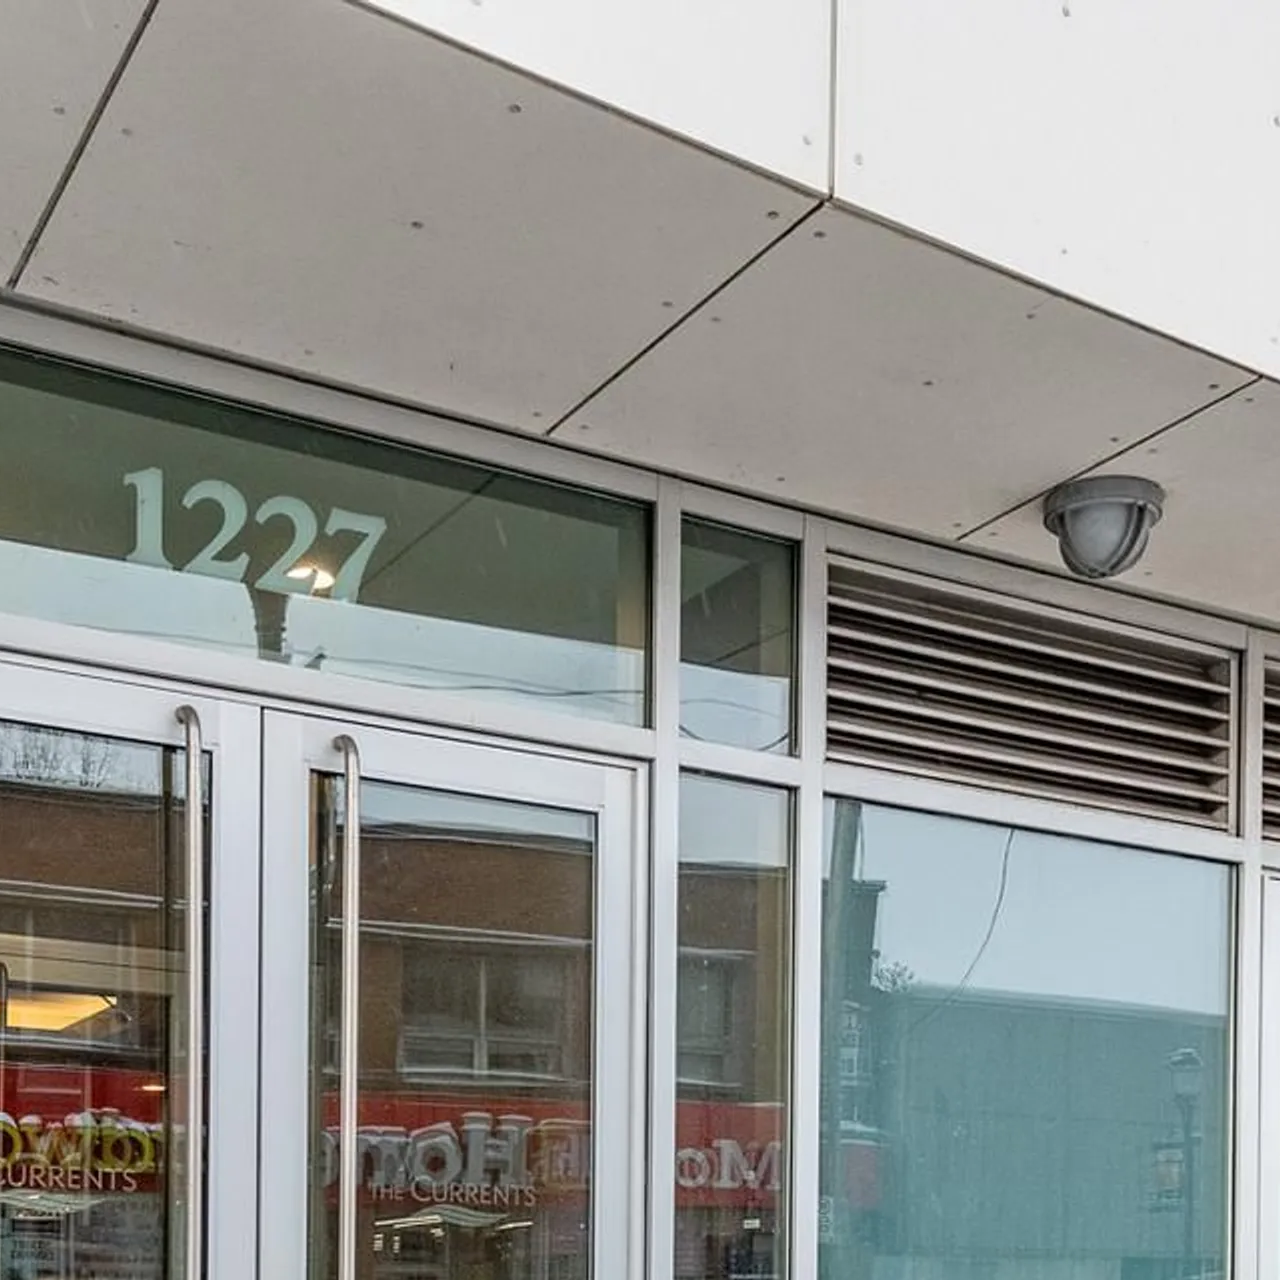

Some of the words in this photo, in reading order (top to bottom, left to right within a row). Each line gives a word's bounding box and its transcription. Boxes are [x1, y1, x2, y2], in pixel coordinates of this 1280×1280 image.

[123, 466, 387, 604] 1227
[369, 1181, 406, 1202] THE
[409, 1175, 537, 1208] CURRENTS
